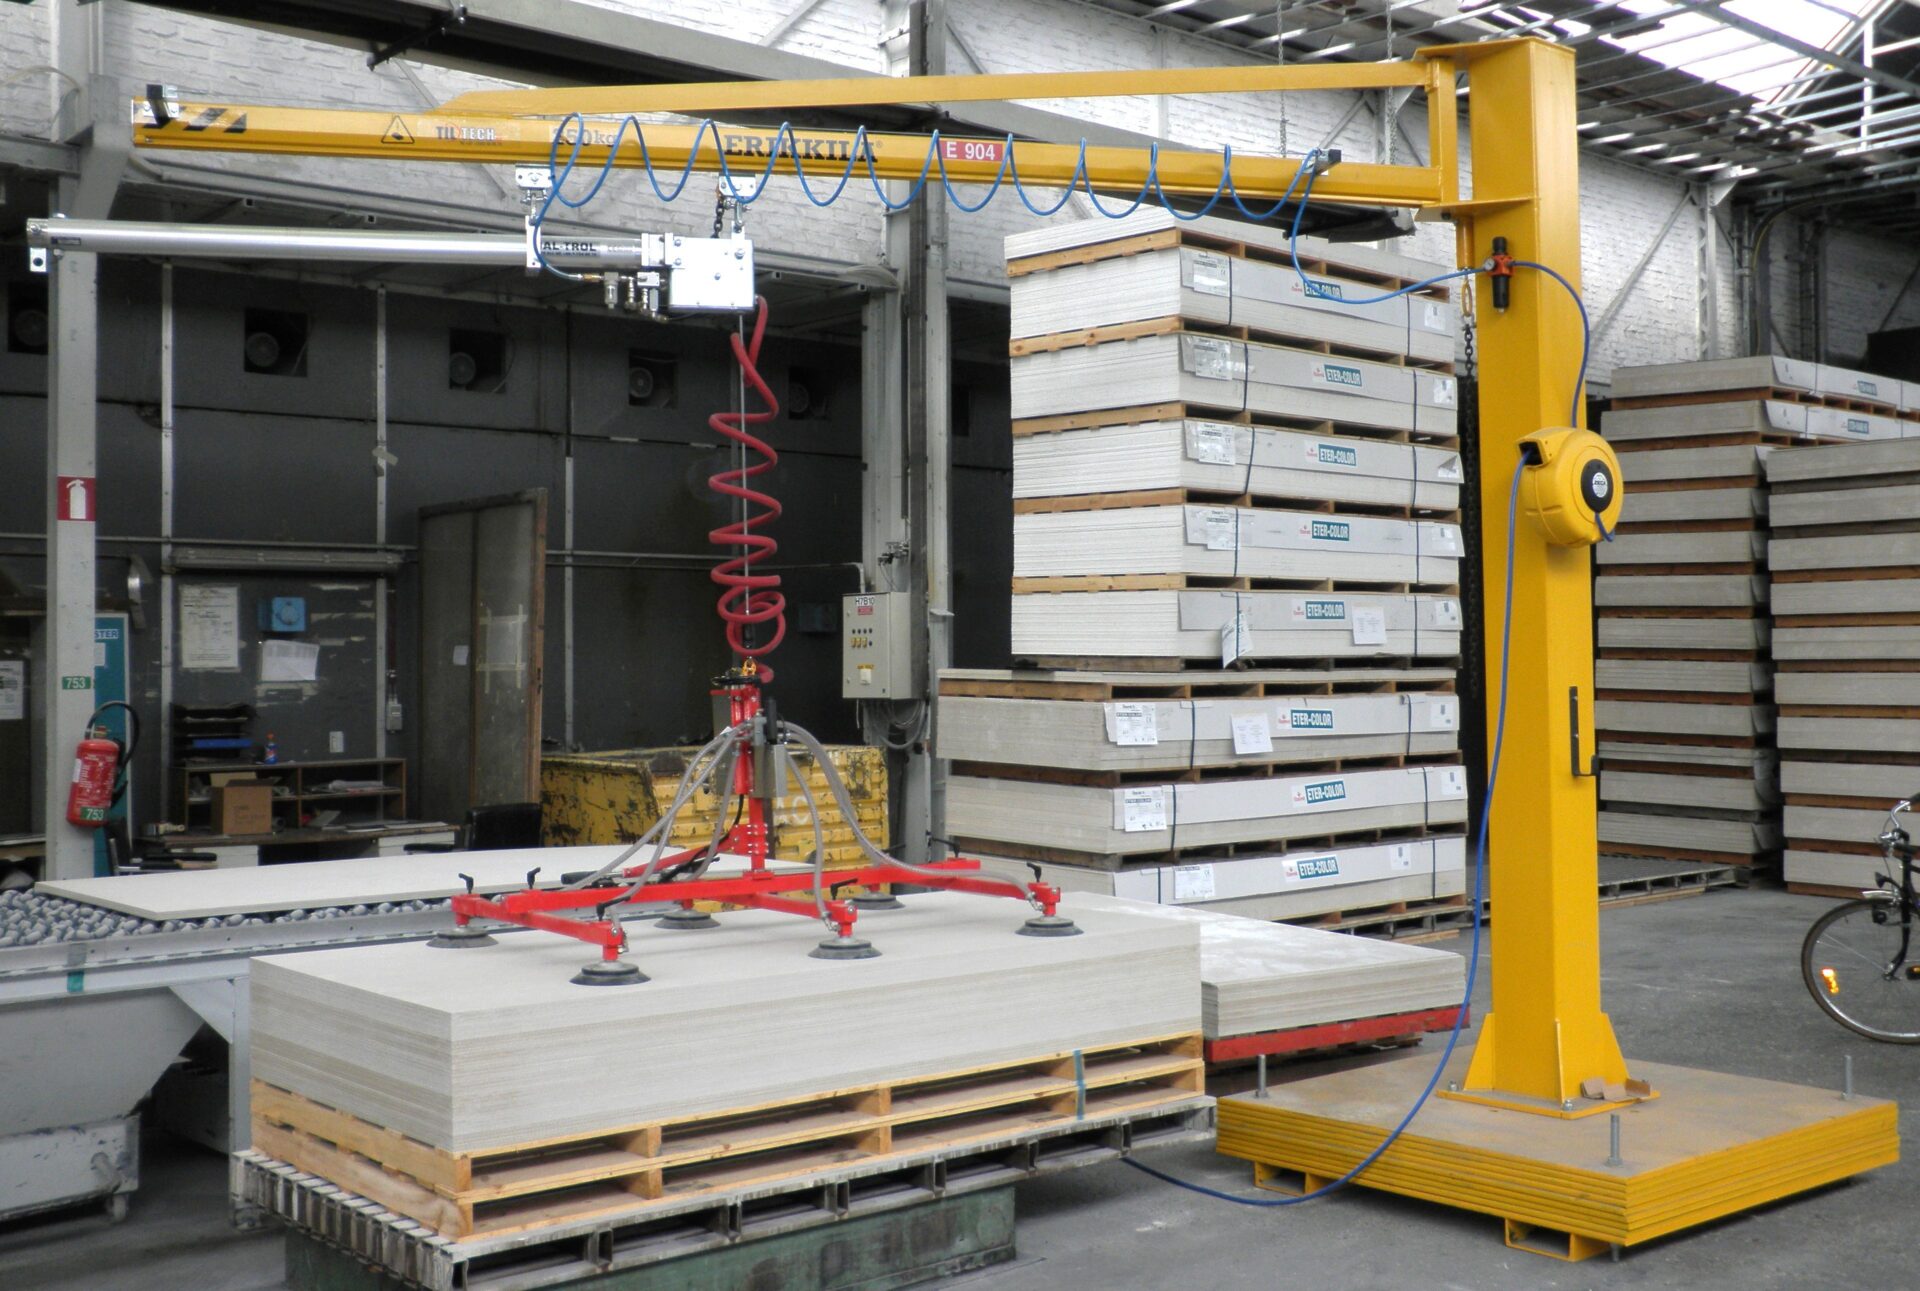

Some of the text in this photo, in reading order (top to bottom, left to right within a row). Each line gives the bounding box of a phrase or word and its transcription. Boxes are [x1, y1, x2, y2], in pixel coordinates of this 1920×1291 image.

[946, 141, 996, 160] E 904
[1326, 368, 1360, 385] ETER-COLOR
[1320, 448, 1355, 465] ETER-COLOR
[1313, 523, 1349, 538] ETER-COLOR
[1307, 604, 1344, 617] ETER-COLOR
[66, 677, 86, 689] 753
[1292, 712, 1332, 726] ETER-COLOR
[1306, 783, 1345, 801] ETER-COLOR
[86, 808, 104, 821] 753
[1299, 859, 1338, 876] ETER-COLOR
